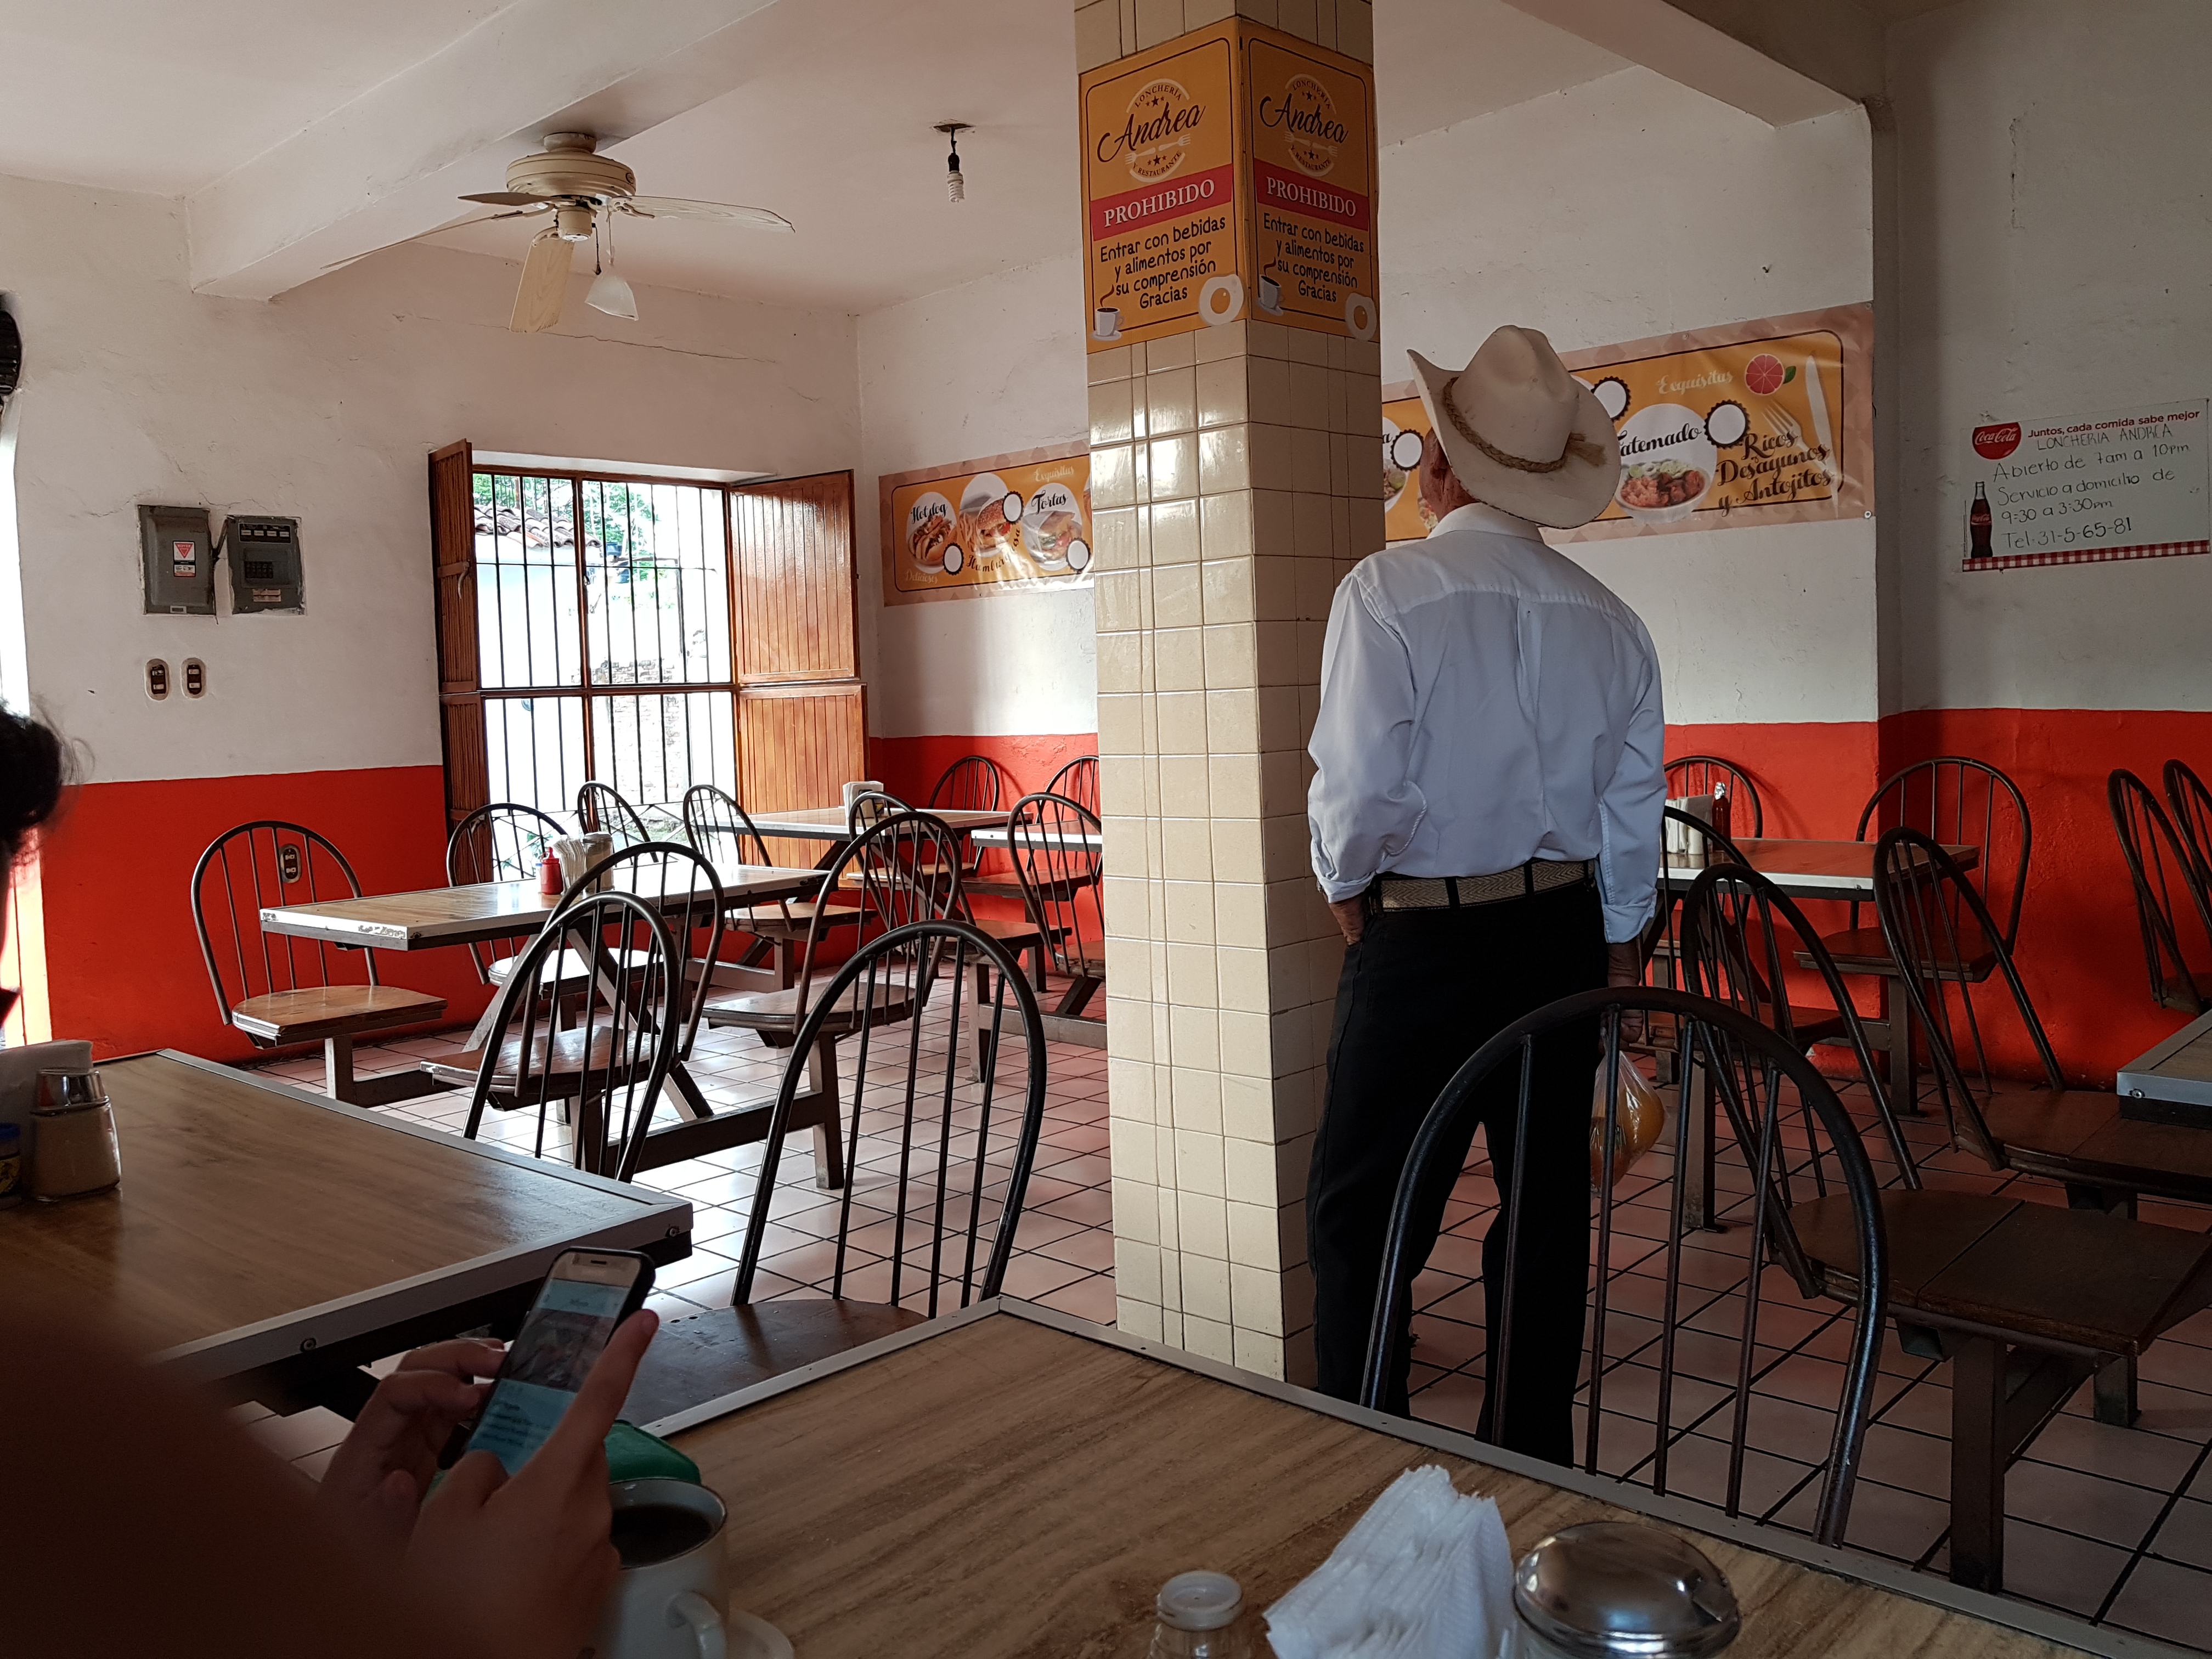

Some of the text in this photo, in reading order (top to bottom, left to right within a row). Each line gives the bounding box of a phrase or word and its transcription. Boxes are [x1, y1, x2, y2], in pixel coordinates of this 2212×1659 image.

[1097, 101, 1206, 162] Andrea
[1260, 93, 1349, 143] Andrea
[1138, 151, 1181, 177] RESTAURANTE
[1295, 152, 1331, 171] RESTAURANTE
[1104, 179, 1215, 228] PROHIBIDO
[1266, 176, 1356, 217] PROHIBIDO
[1101, 216, 1226, 262] Entrar con bebidas
[1263, 212, 1364, 252] Entrar con bebidas
[1115, 241, 1212, 283] y alimentos por
[1276, 240, 1354, 270] y alimentos por
[1116, 259, 1216, 296] su comprensión
[1277, 259, 1357, 288] su comprensión
[1139, 286, 1188, 308] Gracias
[1298, 280, 1336, 302] Gracias
[1657, 370, 1734, 395] Exquisitas
[1975, 427, 2018, 445] Coca-Cola
[2028, 411, 2200, 438] Juntos, cada comida sabe mejor
[1739, 431, 1798, 460] Ricos
[1716, 444, 1830, 487] Desayunos
[1993, 458, 2058, 482] Abierto
[2064, 455, 2085, 469] de
[2134, 450, 2143, 460] a
[2153, 443, 2189, 457] 10pm
[1031, 490, 1068, 515] Tortas
[1719, 469, 1835, 517] y Antojitos
[1997, 486, 2058, 506] Servicio
[2076, 472, 2140, 492] domicilio
[2153, 469, 2175, 481] de
[2042, 507, 2053, 516] a
